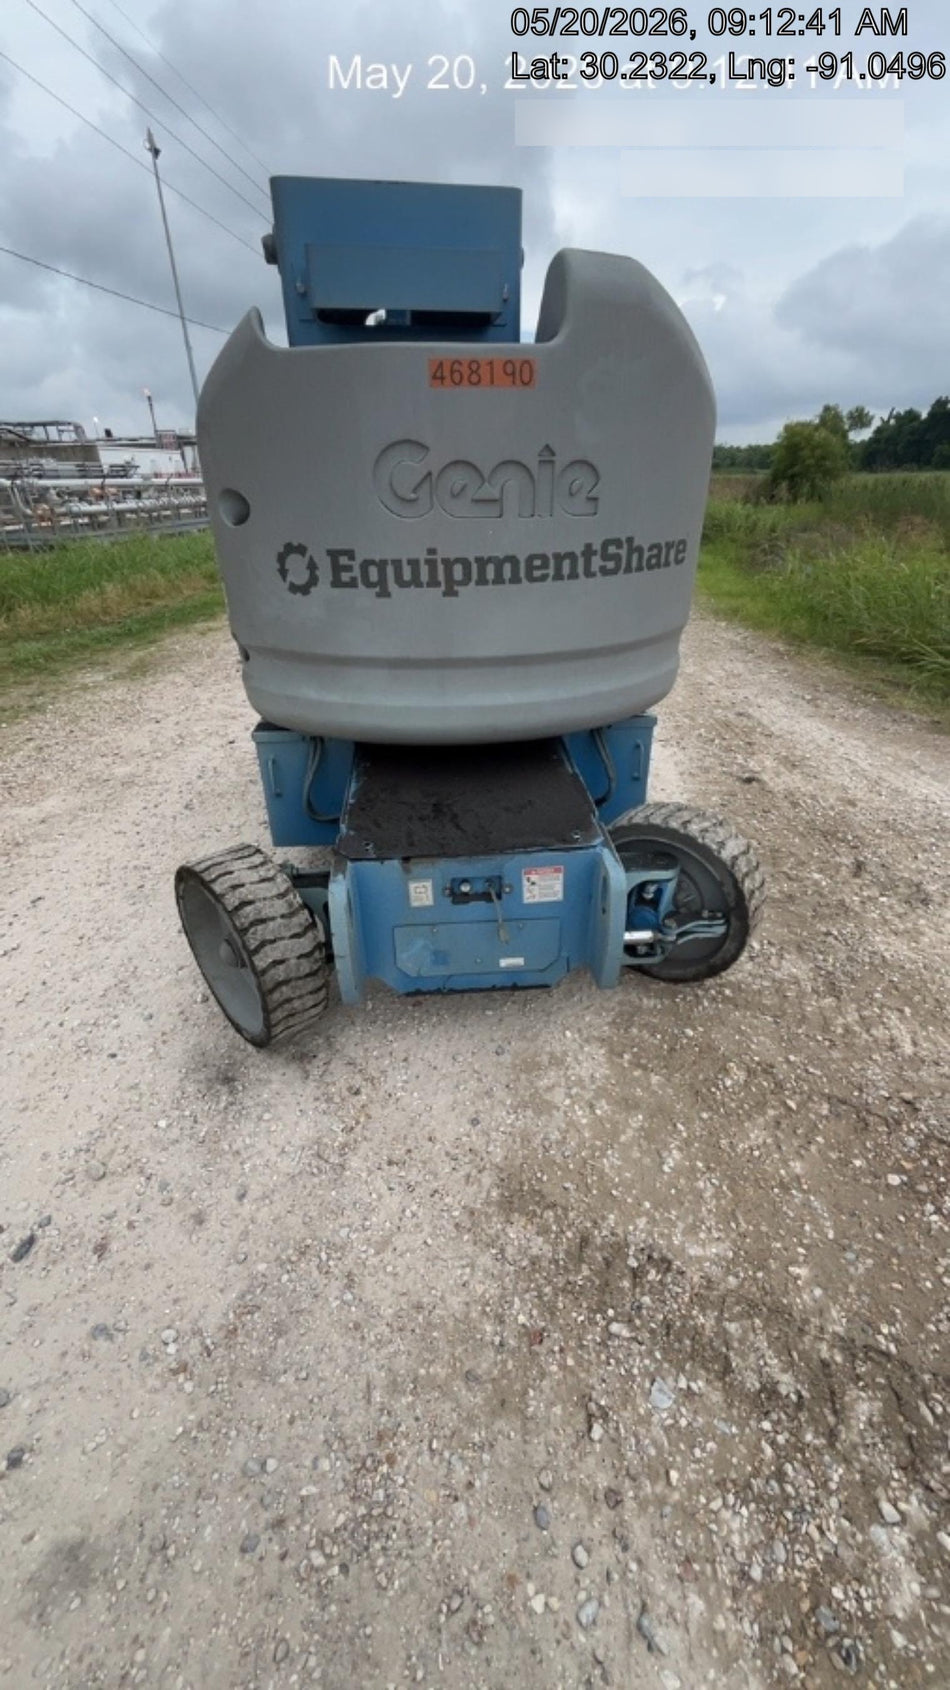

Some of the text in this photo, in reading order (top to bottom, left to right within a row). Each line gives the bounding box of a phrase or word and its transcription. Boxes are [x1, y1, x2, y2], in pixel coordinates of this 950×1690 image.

[430, 359, 535, 387] 468190
[372, 437, 600, 520] Genie
[326, 535, 688, 598] EquipmentShare
